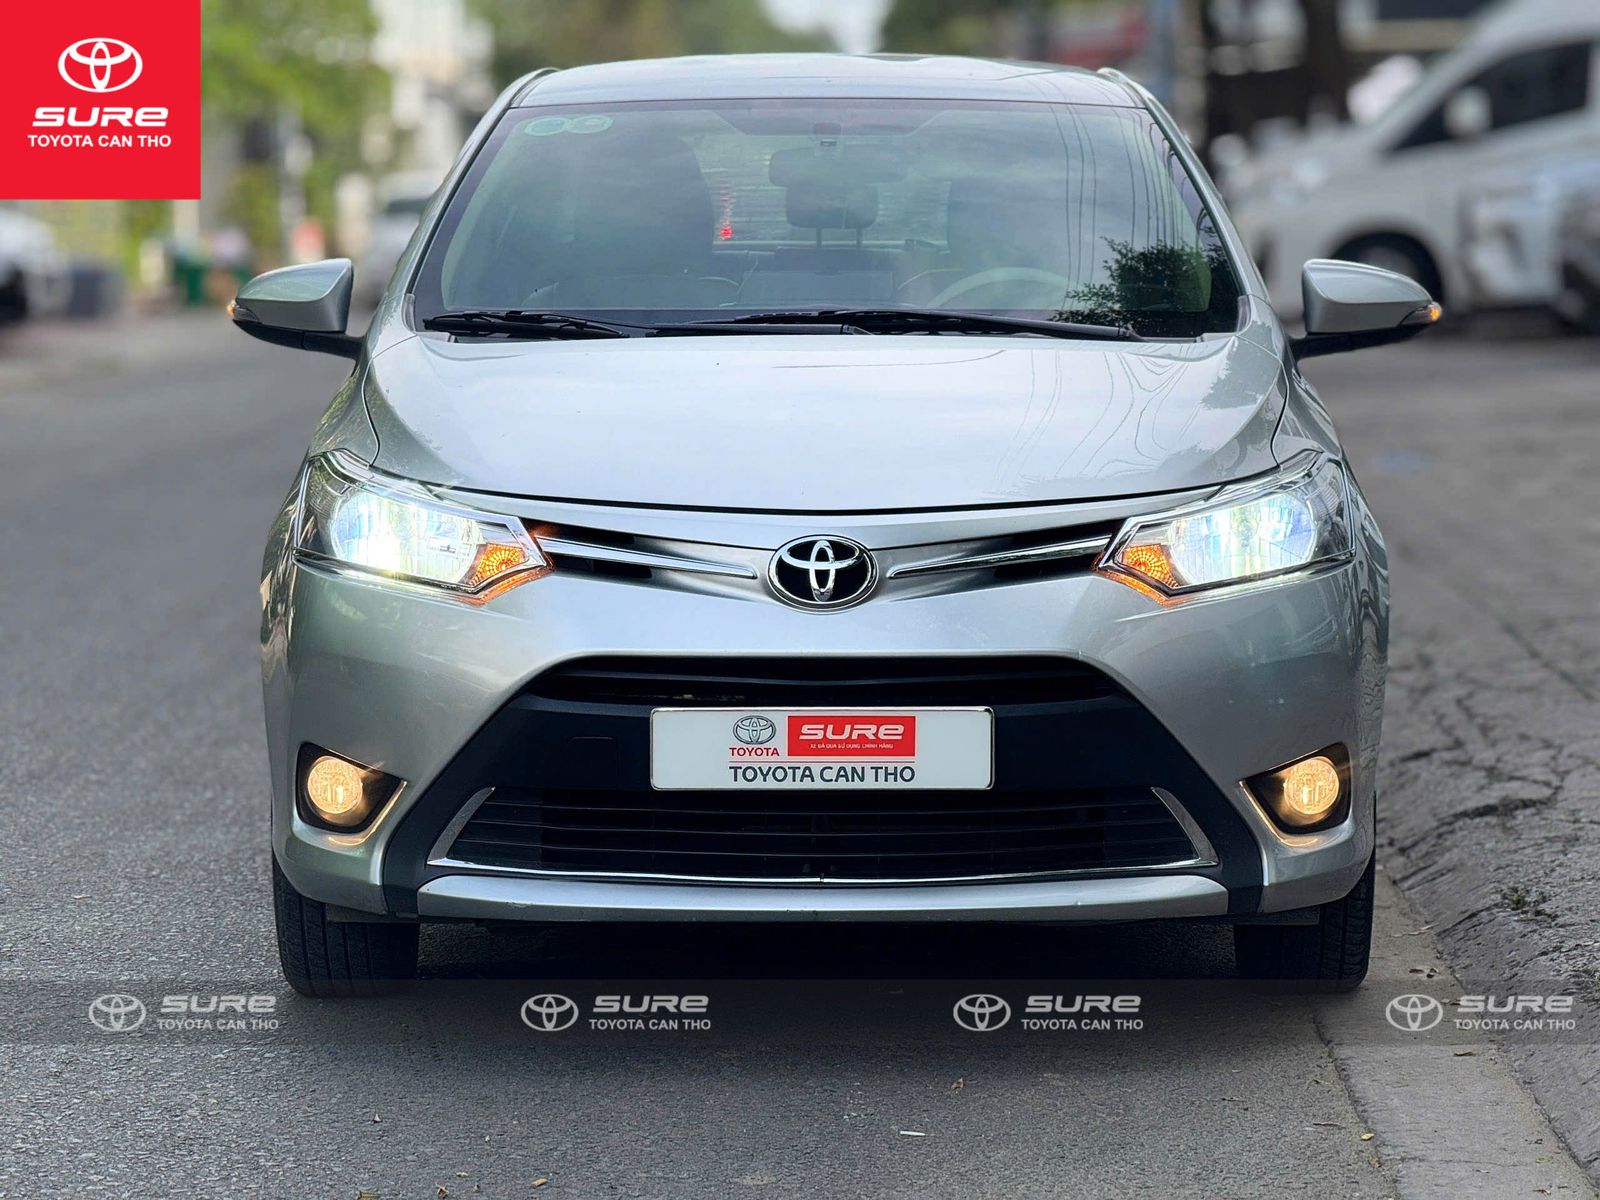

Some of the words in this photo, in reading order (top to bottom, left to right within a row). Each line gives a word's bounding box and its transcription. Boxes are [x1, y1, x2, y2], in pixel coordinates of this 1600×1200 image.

[799, 724, 905, 740] SURE
[729, 747, 780, 757] TOYOTA
[729, 766, 815, 783] TOYOTA
[819, 766, 865, 783] CAN
[870, 766, 916, 783] THO
